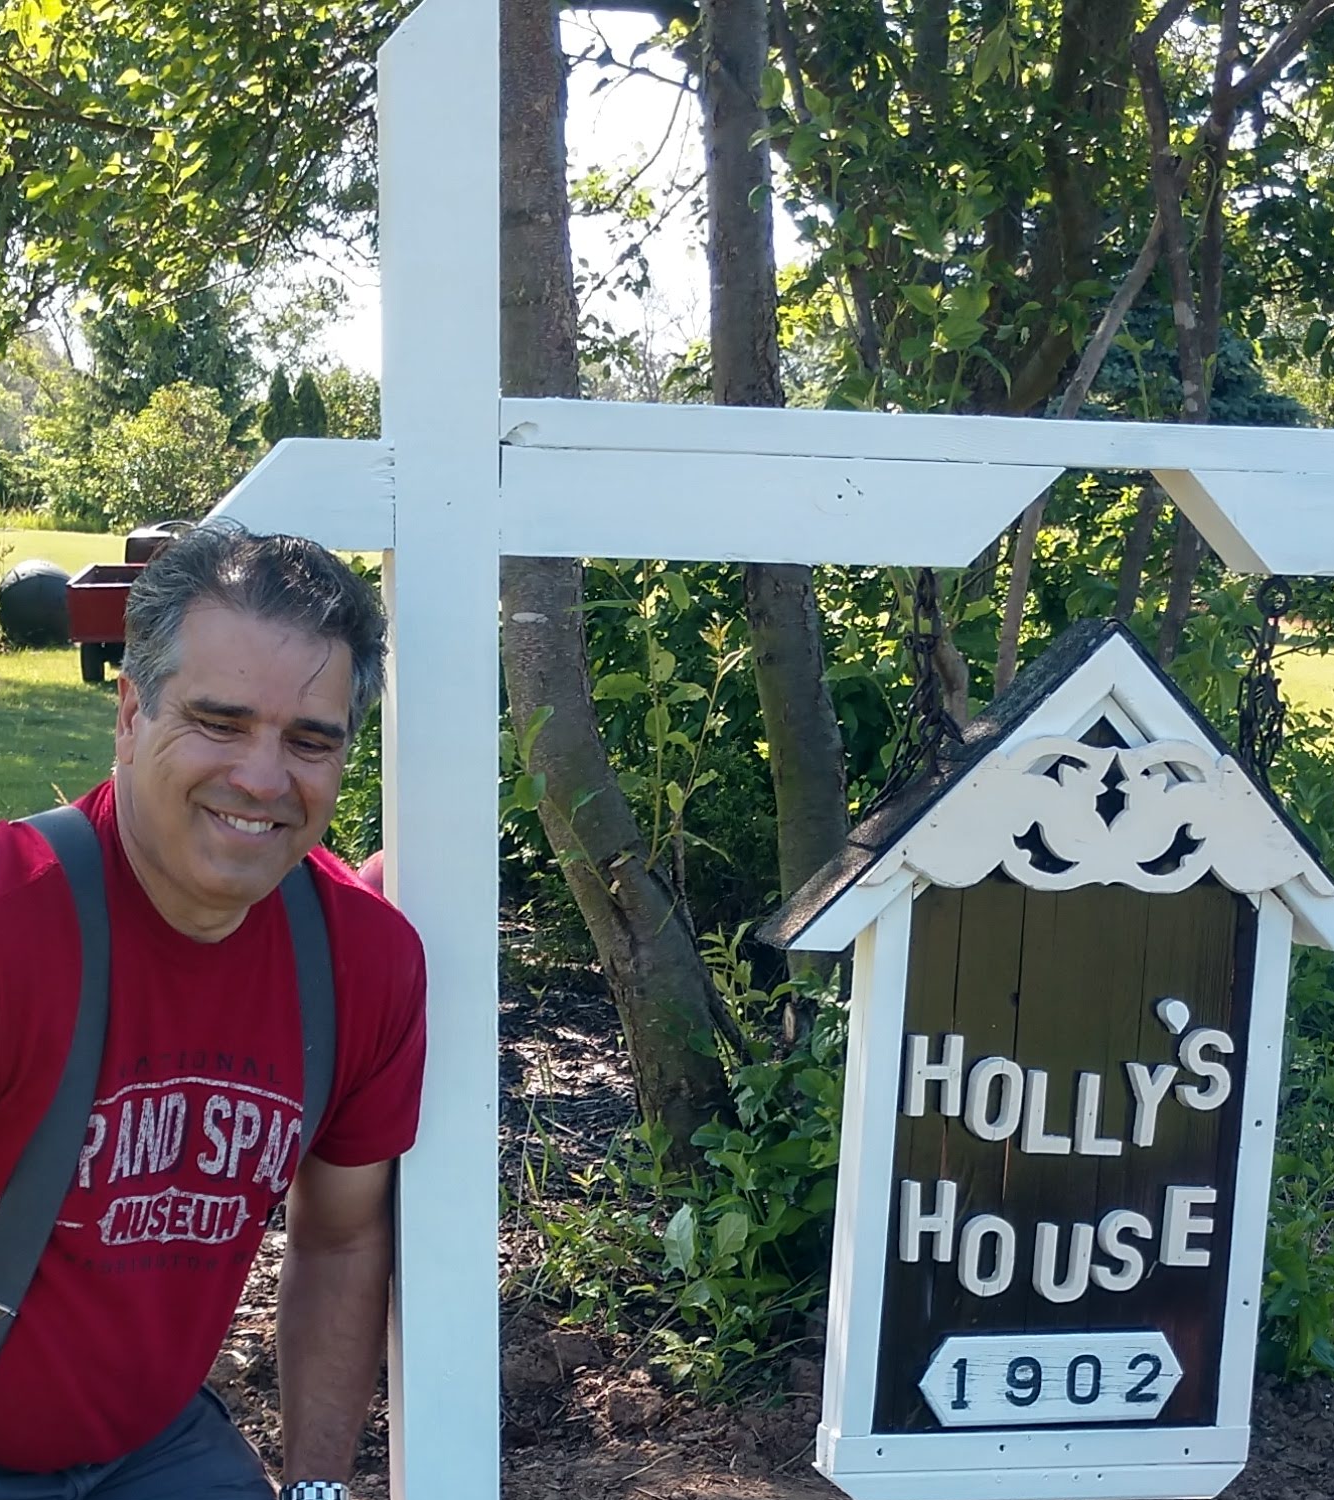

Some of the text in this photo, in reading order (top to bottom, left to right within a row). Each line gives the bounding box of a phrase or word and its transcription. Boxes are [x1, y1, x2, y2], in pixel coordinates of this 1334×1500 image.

[120, 1053, 283, 1084] ATIONAL
[903, 998, 1234, 1155] HOLLY'S
[107, 1092, 187, 1184] AND
[197, 1095, 302, 1193] SPAC
[109, 1196, 241, 1240] MUSEUM
[899, 1180, 1217, 1303] HOUSE
[950, 1353, 1163, 1410] 1902
